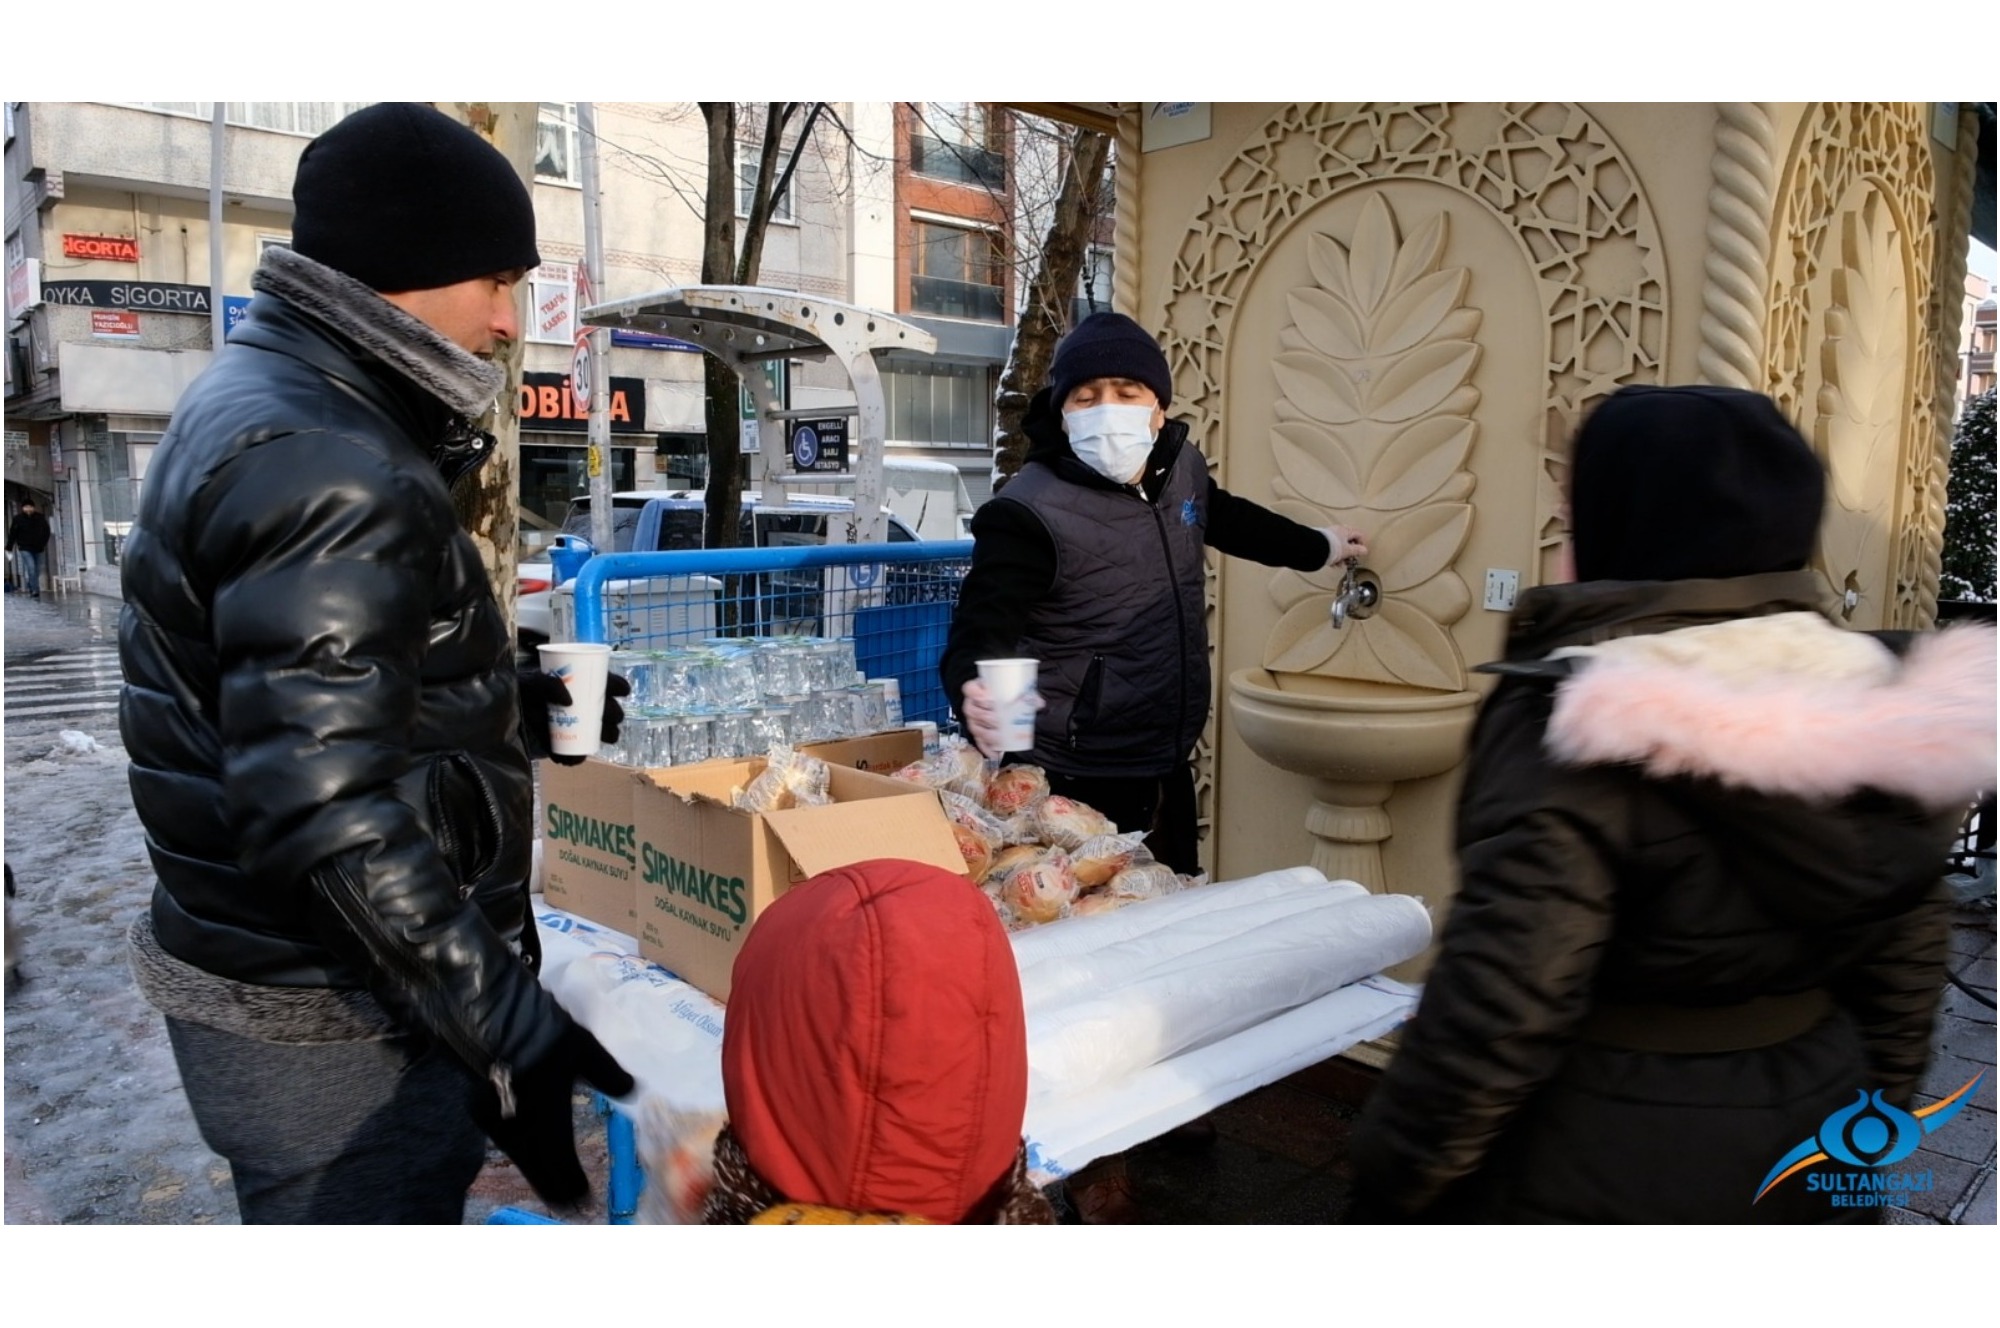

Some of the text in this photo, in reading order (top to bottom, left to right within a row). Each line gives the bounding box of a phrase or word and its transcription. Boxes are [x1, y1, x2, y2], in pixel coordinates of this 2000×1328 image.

[44, 284, 209, 310] OYKA SİGORTA
[541, 292, 567, 314] TRAFİK
[542, 311, 567, 333] KASKO
[575, 357, 589, 391] 30
[559, 849, 629, 881] DOĞAL KAYNAK SUYU
[654, 896, 680, 918] DOĞAL
[679, 904, 709, 931] KAYNAK
[709, 921, 731, 942] SUYU
